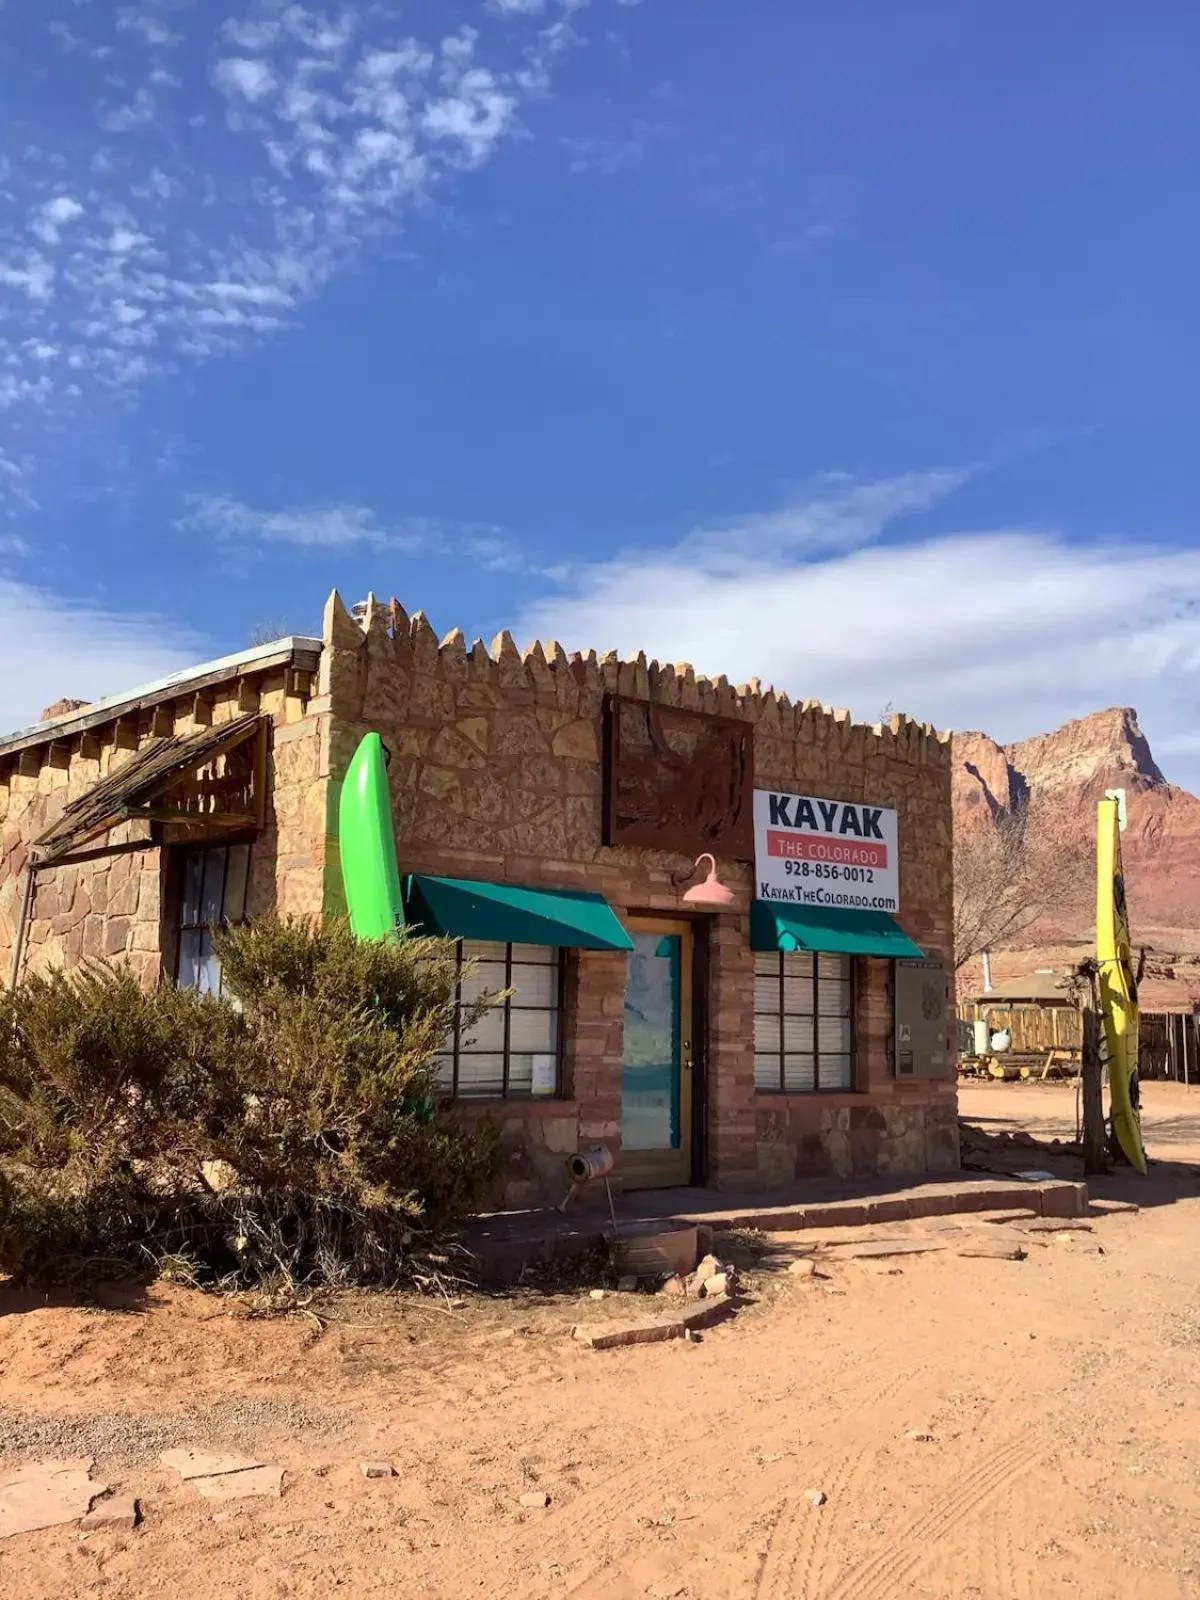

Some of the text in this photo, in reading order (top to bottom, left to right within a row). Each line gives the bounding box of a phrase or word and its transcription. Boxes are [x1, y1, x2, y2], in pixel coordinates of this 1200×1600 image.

[769, 795, 883, 839] KAYAK
[778, 840, 877, 864] THE COLORADO
[785, 861, 873, 883] 928-856-0012
